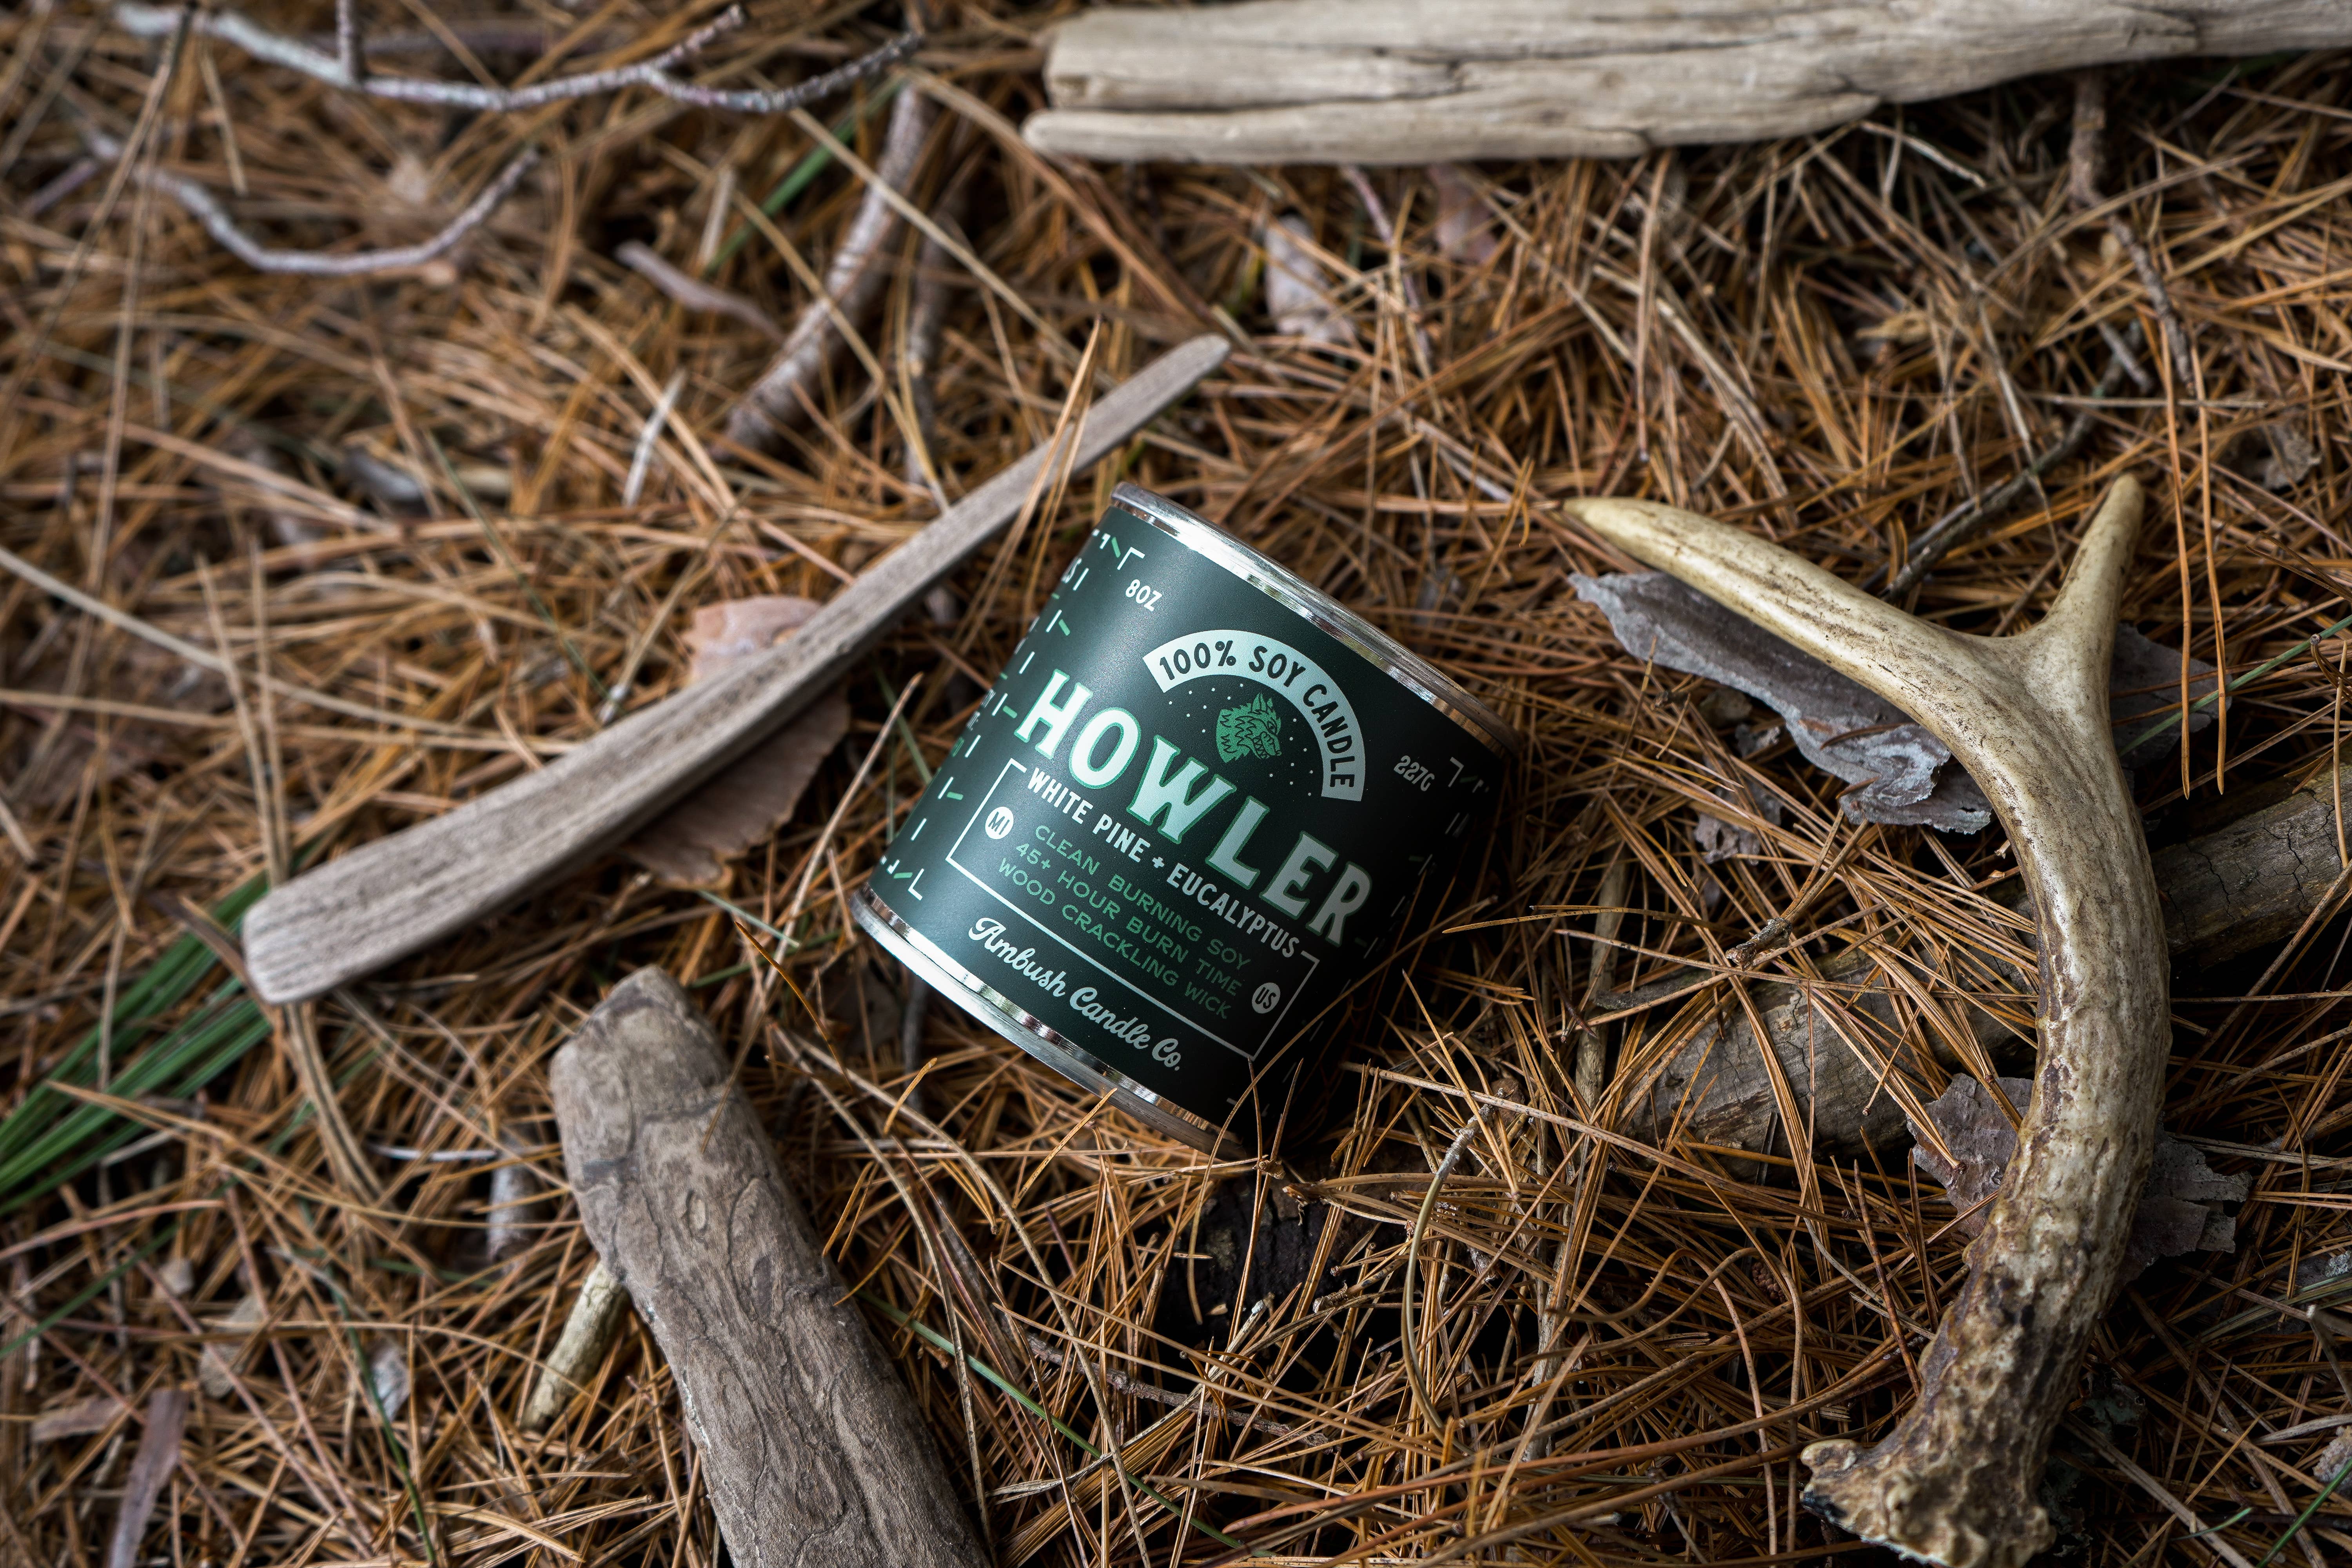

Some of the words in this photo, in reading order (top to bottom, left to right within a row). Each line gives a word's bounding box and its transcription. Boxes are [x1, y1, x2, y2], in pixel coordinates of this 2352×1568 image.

[1159, 640, 1236, 680] 100%
[1249, 646, 1305, 688] SOY
[1303, 684, 1355, 788] CANDLE
[988, 811, 1010, 835] MI
[1014, 668, 1372, 947] HOWLER
[1027, 767, 1093, 824] WHITE
[1093, 813, 1151, 862] PINE
[1152, 857, 1165, 869] +
[1167, 862, 1299, 957] EUCALYPTUS
[999, 858, 1055, 905] WOOD
[1062, 904, 1179, 986] CRACKLING
[1184, 982, 1231, 1019] WICK
[1016, 843, 1051, 869] 45+
[1057, 870, 1120, 920] HOUR
[1126, 916, 1189, 963] BURN
[1196, 958, 1242, 996] TIME
[1035, 825, 1100, 875] CLEAN
[1107, 874, 1203, 942] BURNING
[1207, 938, 1251, 970] SOY
[968, 917, 1065, 997] Ambush
[1069, 987, 1151, 1049] Candle
[1152, 1038, 1181, 1071] Co.
[1255, 987, 1276, 1009] US
